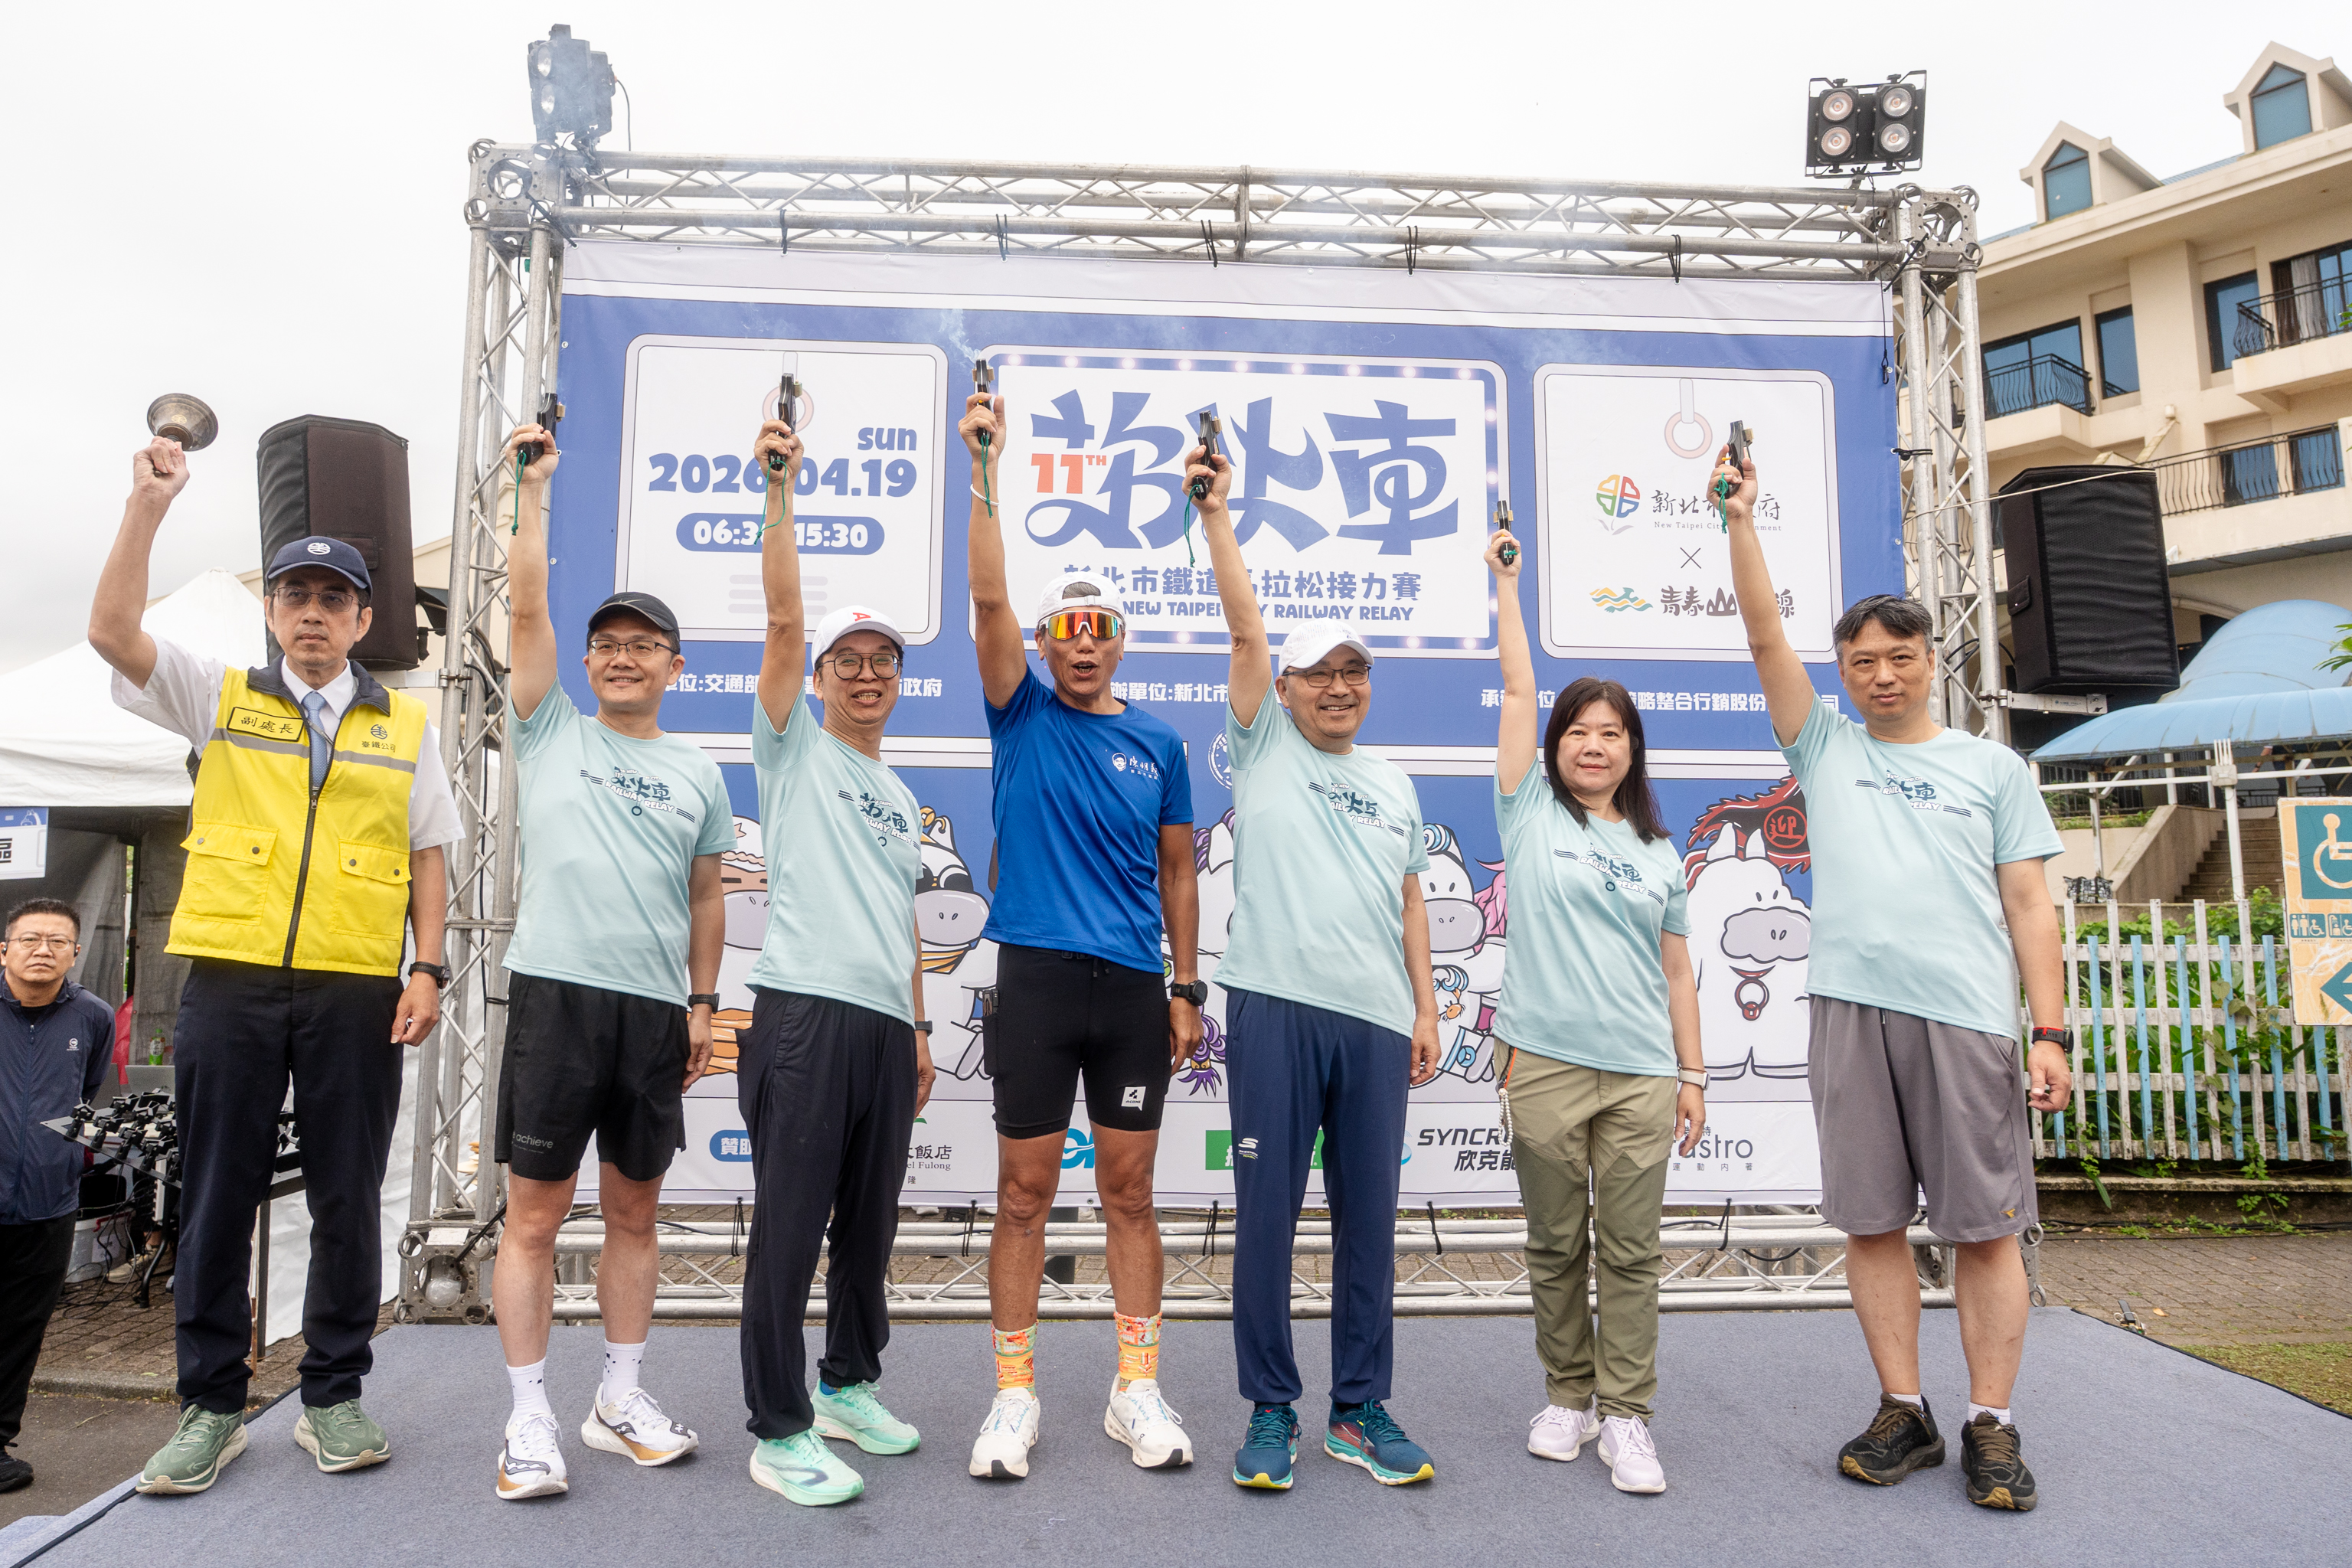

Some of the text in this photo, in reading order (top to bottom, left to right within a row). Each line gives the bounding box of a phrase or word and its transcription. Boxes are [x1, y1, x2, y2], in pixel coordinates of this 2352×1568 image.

[858, 427, 917, 451] sun
[648, 452, 917, 498] 202604.19
[1031, 453, 1107, 494] 11TH
[1651, 489, 1781, 521] 新北市府
[1122, 601, 1161, 616] NEW
[1167, 602, 1221, 617] TAIPEI
[1274, 604, 1354, 620] RAILWAY
[1359, 606, 1414, 621] RELAY
[1660, 585, 1795, 619] 青春山線
[240, 716, 295, 734] 副處長
[361, 740, 397, 753] 臺鐵公司
[644, 800, 675, 812] RELAY
[1357, 816, 1385, 828] RELAY
[1579, 856, 1646, 893] RAILWA RELAY
[516, 1134, 554, 1148] achieve
[1417, 1129, 1508, 1146] SYNCR
[919, 1161, 951, 1171] Fulong
